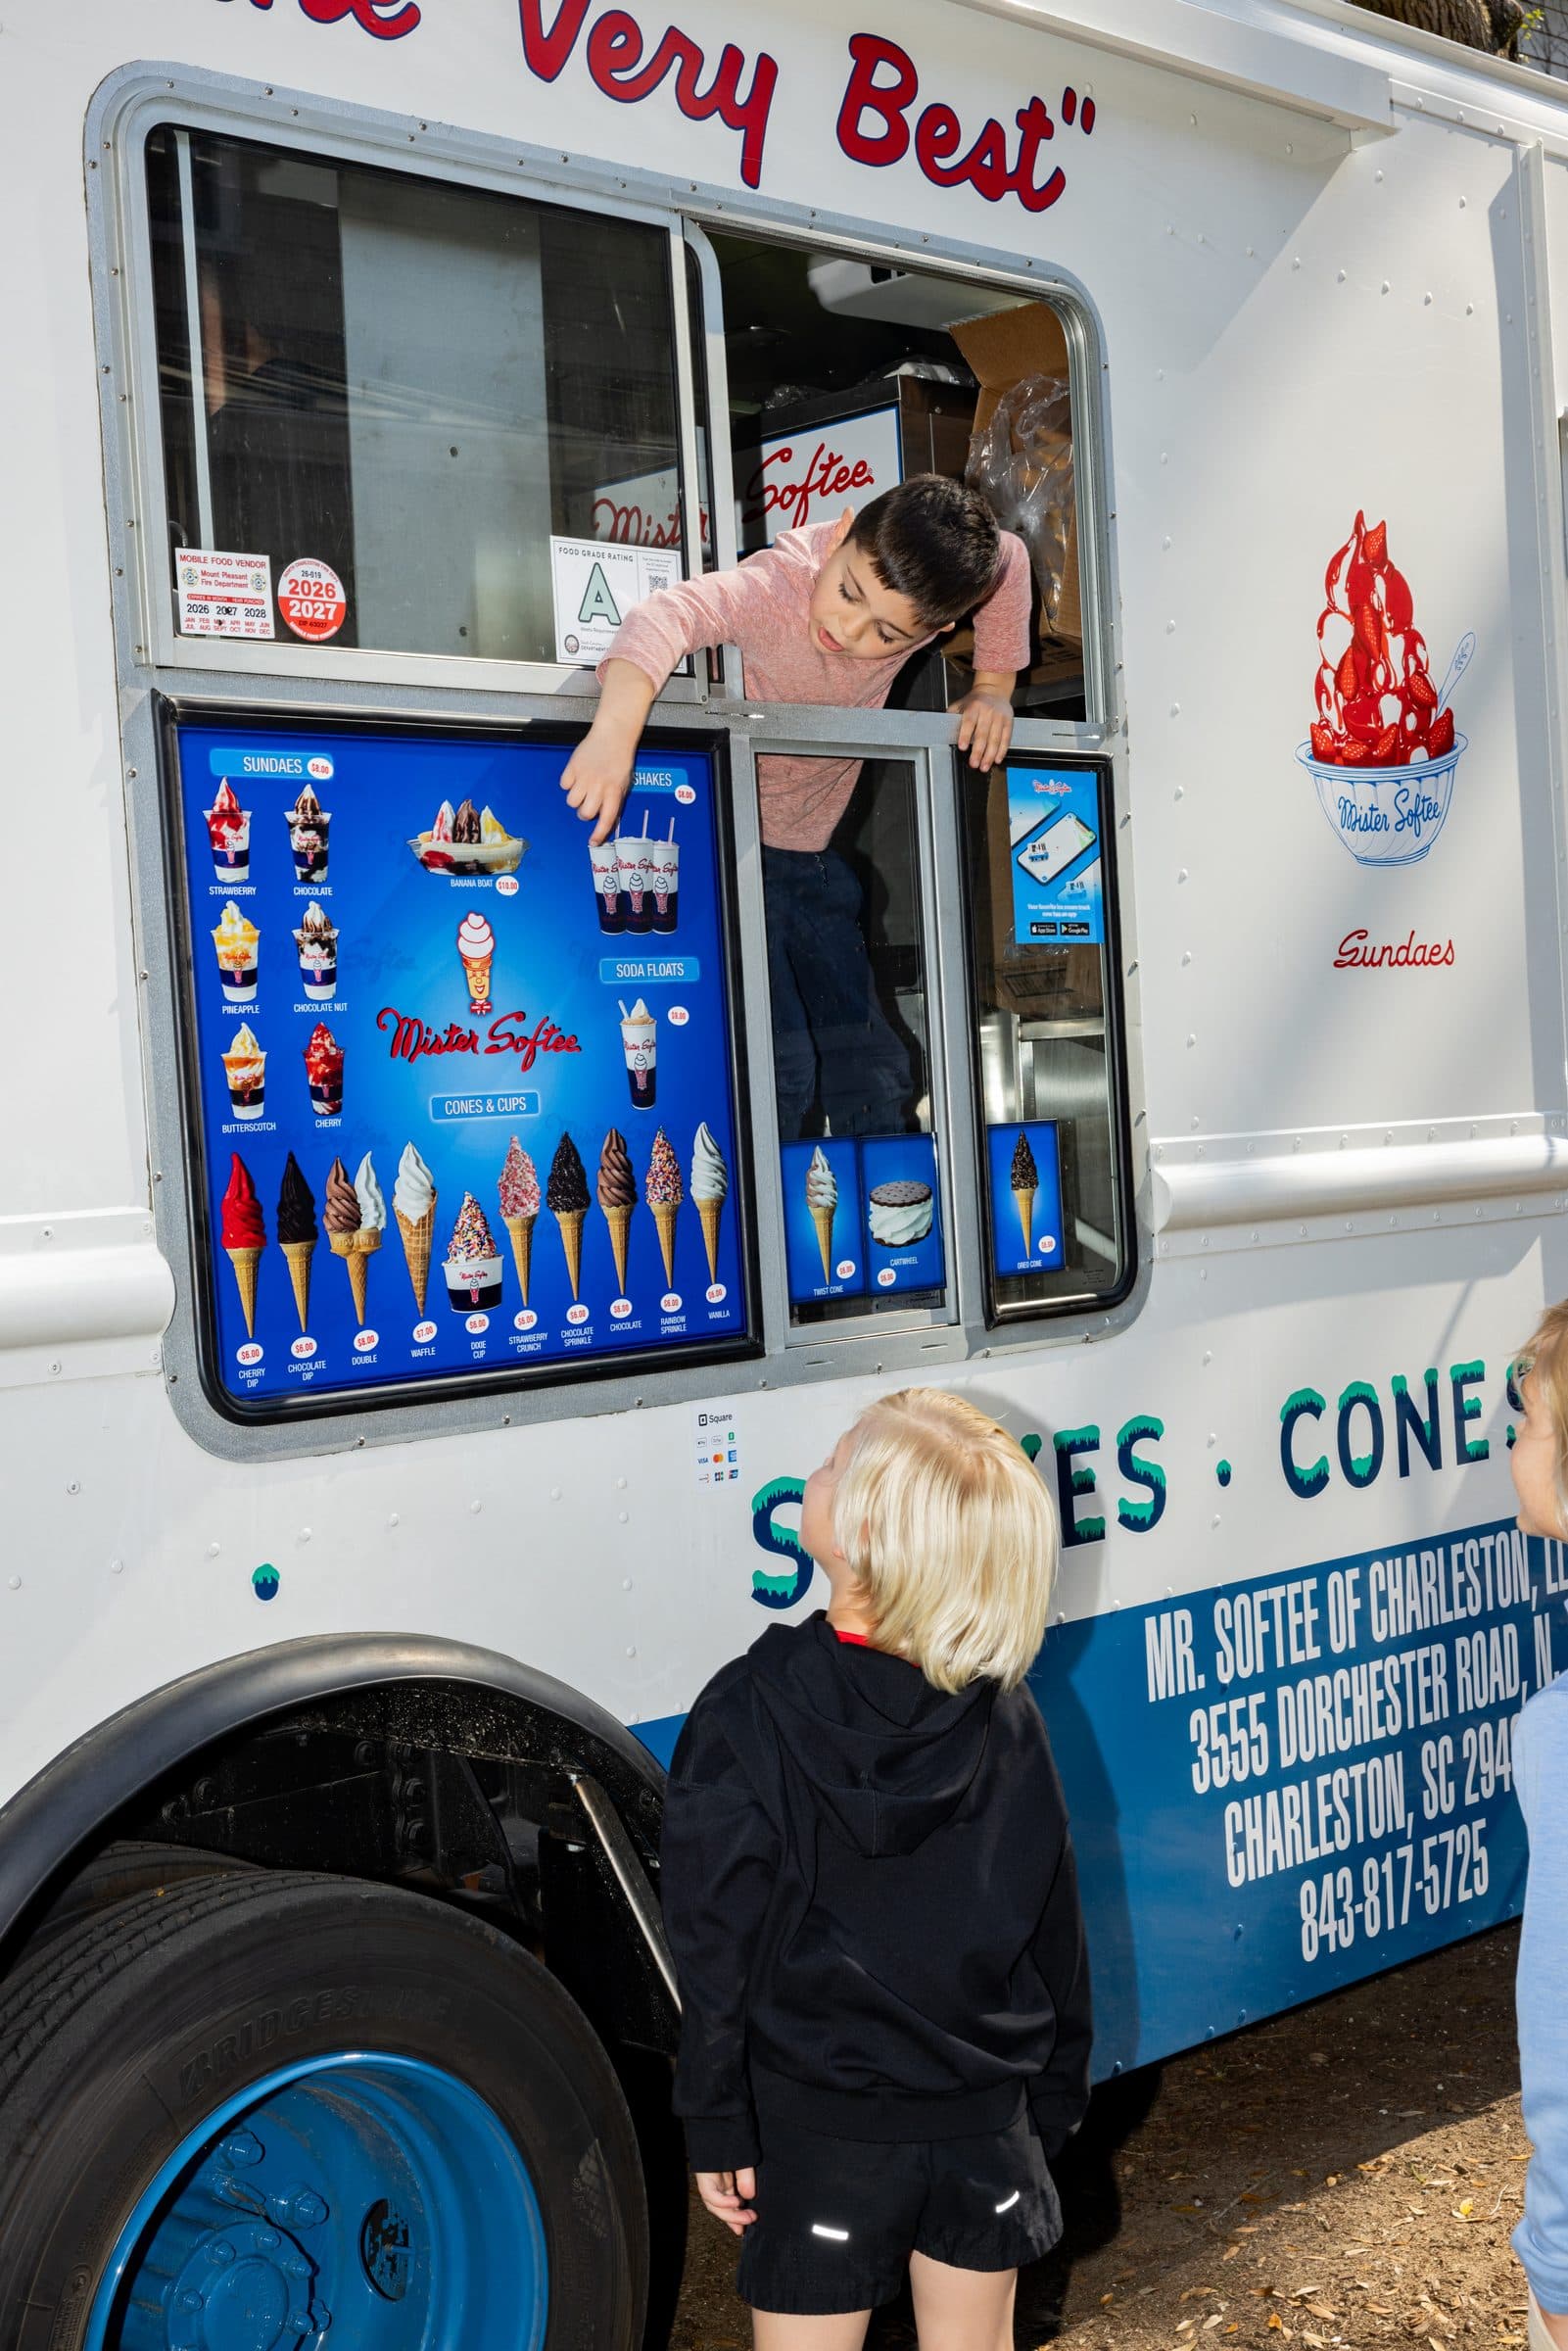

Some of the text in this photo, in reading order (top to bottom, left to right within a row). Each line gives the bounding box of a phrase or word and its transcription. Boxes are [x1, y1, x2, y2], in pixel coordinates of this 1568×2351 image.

[518, 0, 1096, 213] Very Best"
[742, 443, 875, 529] Softee
[558, 547, 634, 562] FOOD GRADE RATING
[179, 554, 266, 569] MOBILE FOOD VENDOR
[221, 571, 248, 581] Pleasant
[214, 580, 249, 589] Department
[288, 578, 337, 600] 2026
[578, 561, 622, 626] A
[187, 603, 210, 614] 2026
[245, 608, 266, 618] 2028
[288, 600, 338, 621] 2027
[243, 756, 303, 774] SUNDAES
[634, 771, 673, 787] SHAKES
[1338, 788, 1442, 838] Mister Softee
[450, 879, 494, 888] BANANA BOAT
[209, 886, 257, 895] STRAWBERRY
[293, 886, 333, 896] CHOCOLATE
[1333, 929, 1455, 969] Sundaes
[616, 962, 685, 978] SODA FLOATS
[221, 1004, 260, 1014] PINEAPPLE
[293, 1002, 348, 1013] CHOCOLATE NUT
[376, 1007, 582, 1073] Mister Softee
[445, 1096, 527, 1115] CONES & CUPS
[221, 1122, 276, 1133] BUTTERSCOTCH
[315, 1119, 342, 1128] CHERRY
[889, 1256, 918, 1267] CARTWHEEL
[1030, 1259, 1042, 1268] CONE
[814, 1285, 843, 1296] TWIST CONE
[660, 1315, 687, 1325] RAINBOW
[708, 1309, 731, 1319] VANILLA
[416, 1325, 434, 1338] $7.00
[560, 1326, 594, 1337] CHOCOLATE
[609, 1319, 642, 1332] CHOCOLATE
[660, 1323, 688, 1334] SPRINKLE
[508, 1332, 548, 1345] STRAWBERRY
[563, 1336, 593, 1347] SPRINKLE
[295, 1341, 313, 1354] $6.00
[470, 1340, 487, 1350] DIXIE
[516, 1342, 542, 1353] CRUNCH
[241, 1348, 260, 1360] $6.00
[410, 1346, 436, 1358] WAFFLE
[473, 1350, 486, 1359] CUP
[352, 1354, 378, 1366] DOUBLE
[288, 1360, 327, 1373] CHOCOLATE
[238, 1367, 265, 1379] CHERRY
[302, 1371, 314, 1381] DIP
[247, 1378, 259, 1388] DIP
[708, 1414, 733, 1423] Square
[1144, 1607, 1205, 1703] MR.
[1213, 1577, 1321, 1684] SOFTEE
[1327, 1567, 1361, 1654] OF
[1369, 1528, 1538, 1643] CHARLESTON,
[1189, 1692, 1268, 1795] 3555
[1276, 1643, 1449, 1768] DORCHESTER
[1455, 1623, 1528, 1714] ROAD,
[1224, 1712, 1521, 1888] CHARLESTON, SC 294
[1300, 1818, 1490, 1962] 843-817-5725
